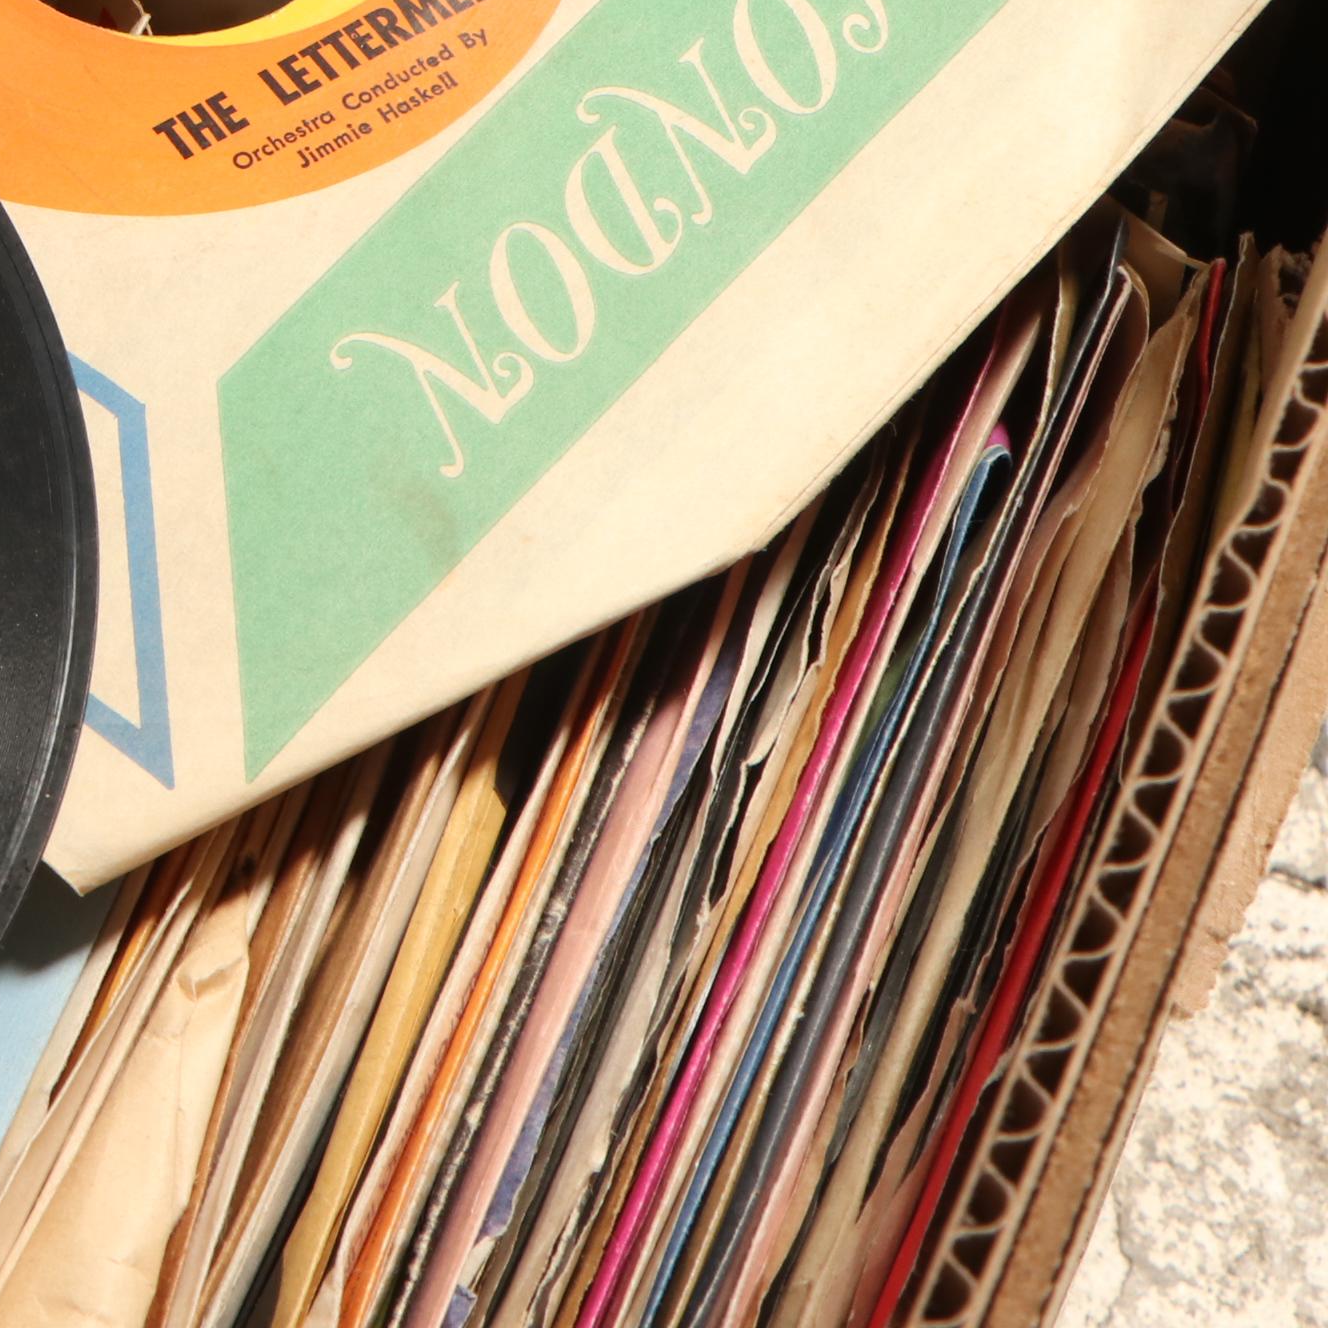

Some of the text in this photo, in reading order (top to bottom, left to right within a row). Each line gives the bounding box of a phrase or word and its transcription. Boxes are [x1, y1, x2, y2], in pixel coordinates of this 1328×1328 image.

[152, 91, 251, 161] THE
[231, 26, 490, 171] Orchestra Conducted By
[296, 71, 460, 169] Jimmie Haskell
